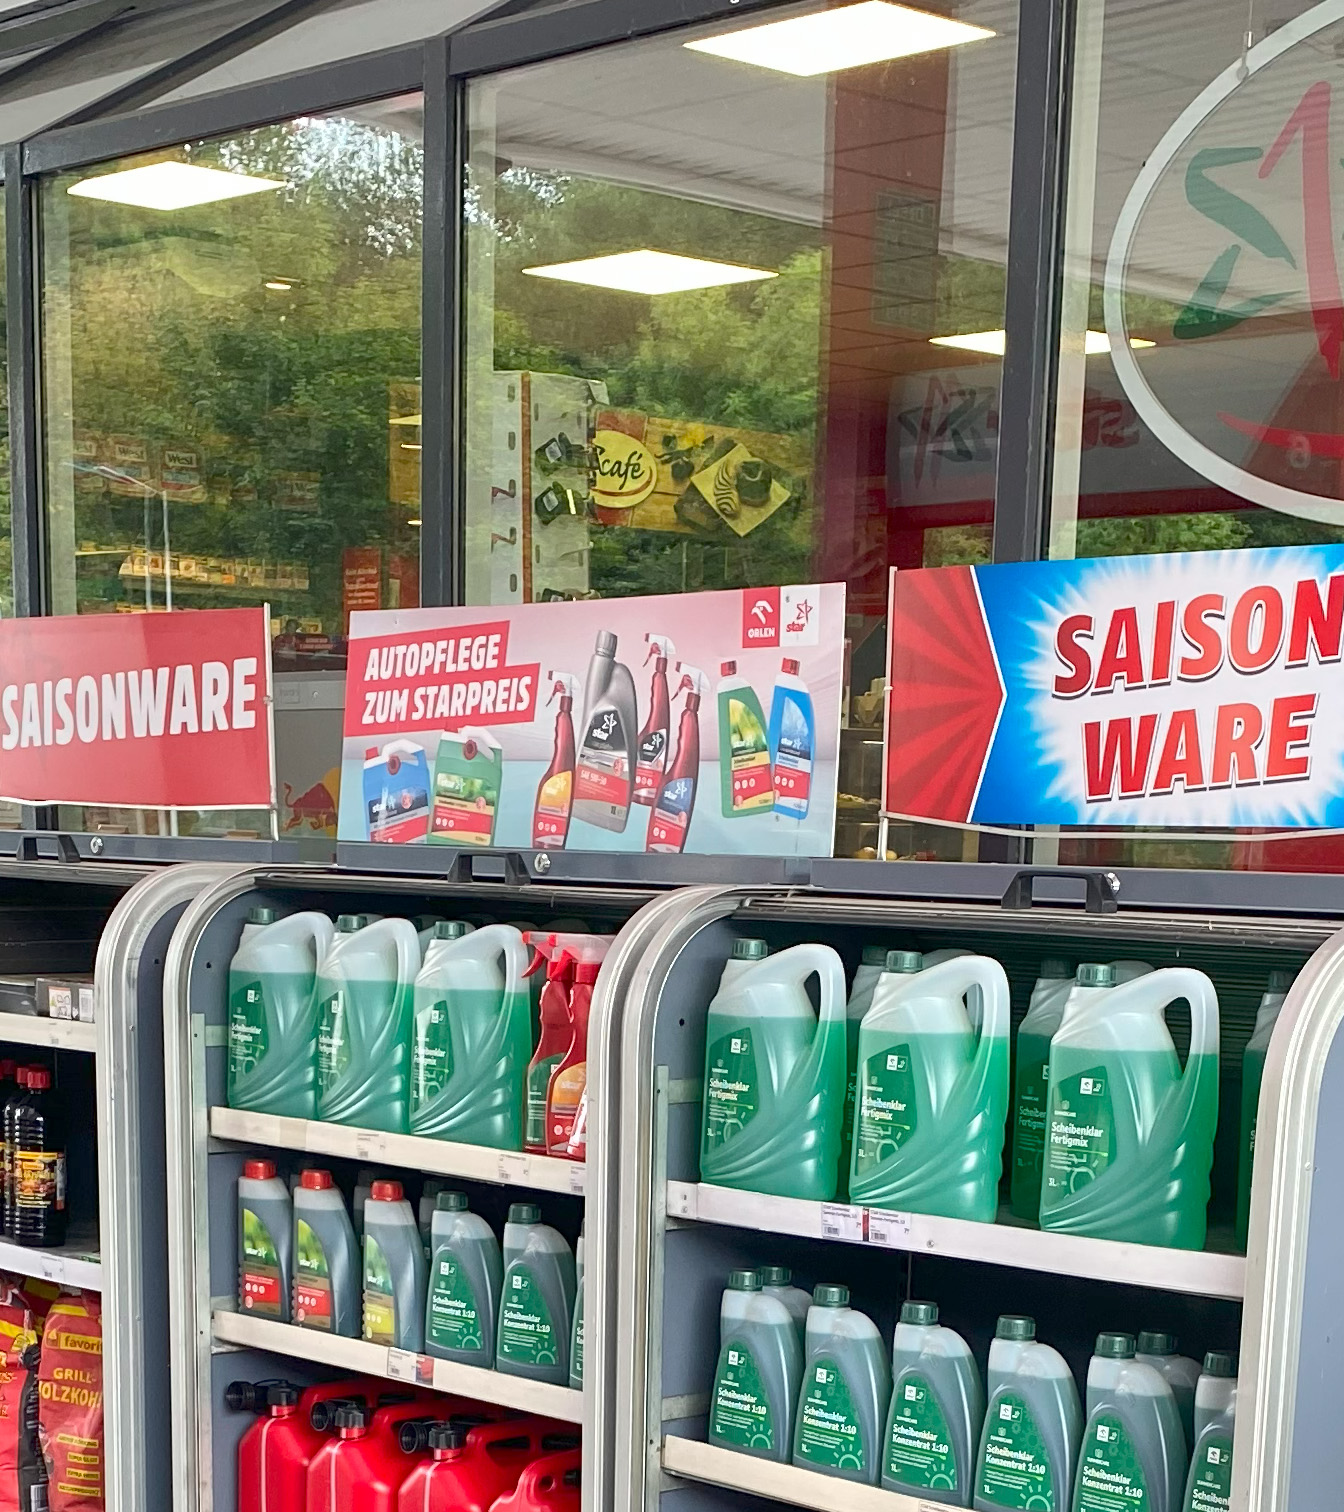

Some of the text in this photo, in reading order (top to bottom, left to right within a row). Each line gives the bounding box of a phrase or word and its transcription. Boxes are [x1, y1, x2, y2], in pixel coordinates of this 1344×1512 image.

[167, 454, 194, 464] West
[601, 450, 645, 490] café
[748, 627, 775, 639] ORLEN
[786, 622, 806, 633] star
[363, 634, 501, 681] AUTOPFLEGE
[2, 657, 257, 750] SAISONWARE
[361, 676, 532, 724] ZUM STARPREIS
[1083, 693, 1319, 803] WARE
[709, 1077, 750, 1092] Scheibenklar
[708, 1088, 738, 1101] Fertigmix
[862, 1095, 906, 1112] Scheibenklar
[1019, 1105, 1047, 1118] Scheiben
[861, 1107, 893, 1121] Fertigmix
[1051, 1121, 1103, 1137] Scheibenklar
[1051, 1132, 1088, 1147] Fertigmix
[718, 1387, 757, 1404] Scheibenklar
[717, 1397, 766, 1415] Konzentrat 1:10
[805, 1405, 847, 1422] Scheibenklar
[803, 1415, 857, 1435] Konzentrat 1:10
[893, 1423, 938, 1441] Scheibenklar
[892, 1433, 949, 1454] Konzentrat 1:10
[986, 1444, 1035, 1462] Scheibenklar
[985, 1453, 1046, 1475] Konzentrat 1:10
[1083, 1465, 1132, 1485] Scheibenklar
[1082, 1476, 1143, 1499] Konzentrat 1:10
[1192, 1489, 1230, 1506] Scheiben
